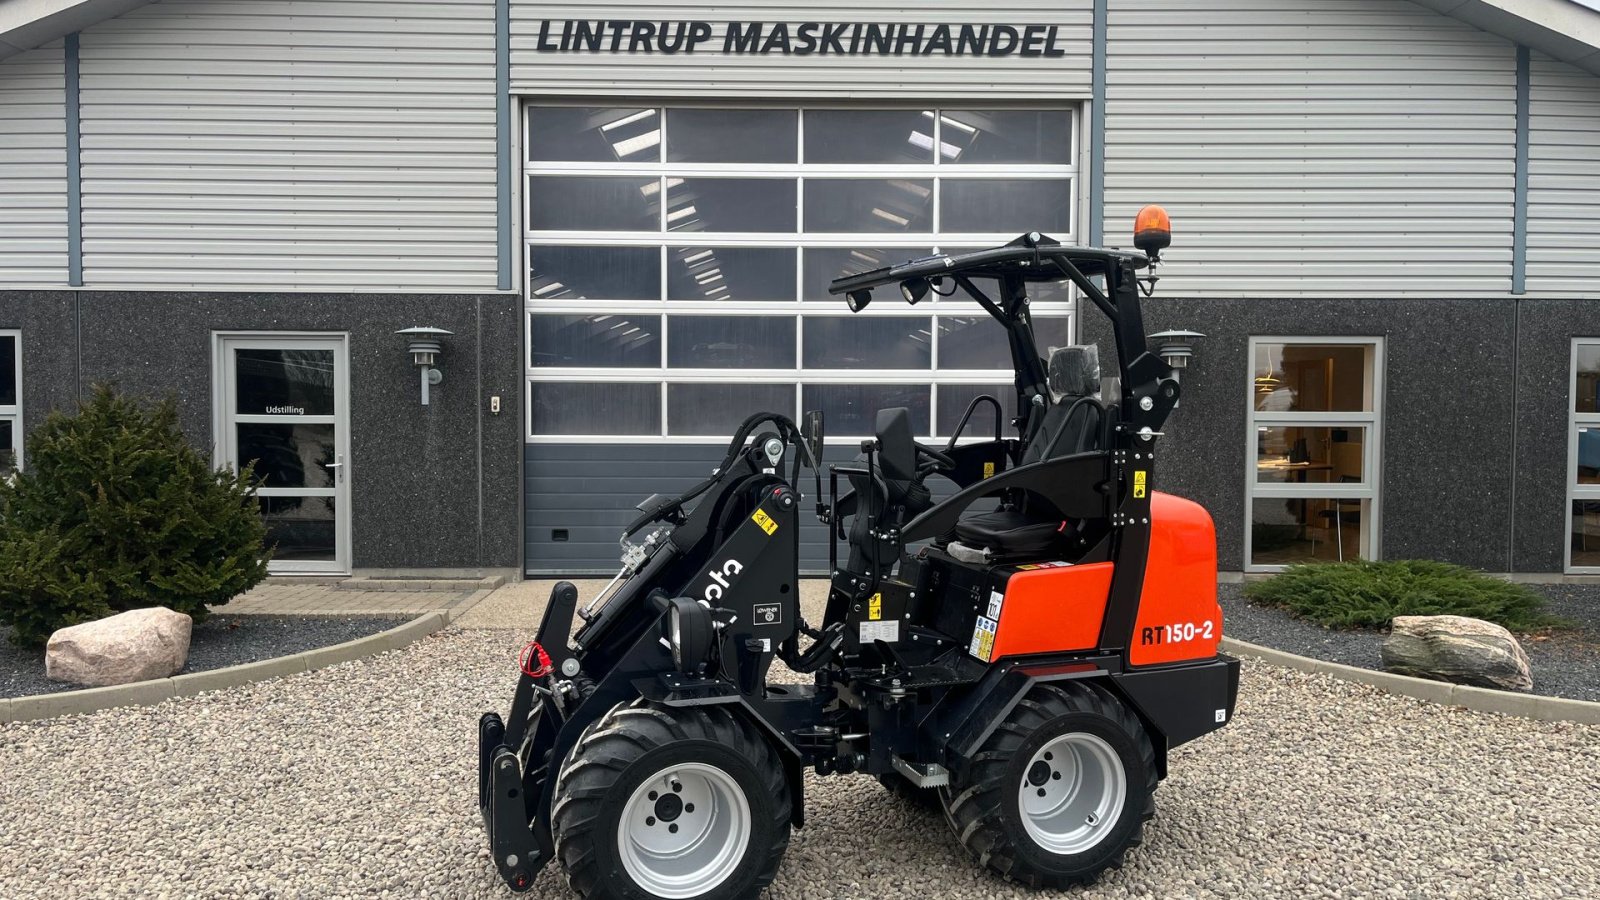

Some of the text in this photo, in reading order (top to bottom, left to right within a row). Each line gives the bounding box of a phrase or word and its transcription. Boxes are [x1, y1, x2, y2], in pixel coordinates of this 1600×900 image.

[537, 20, 1065, 57] LINTRUP MASKINHANDEL
[265, 405, 304, 416] Udstilling
[1142, 620, 1213, 645] RT150-2
